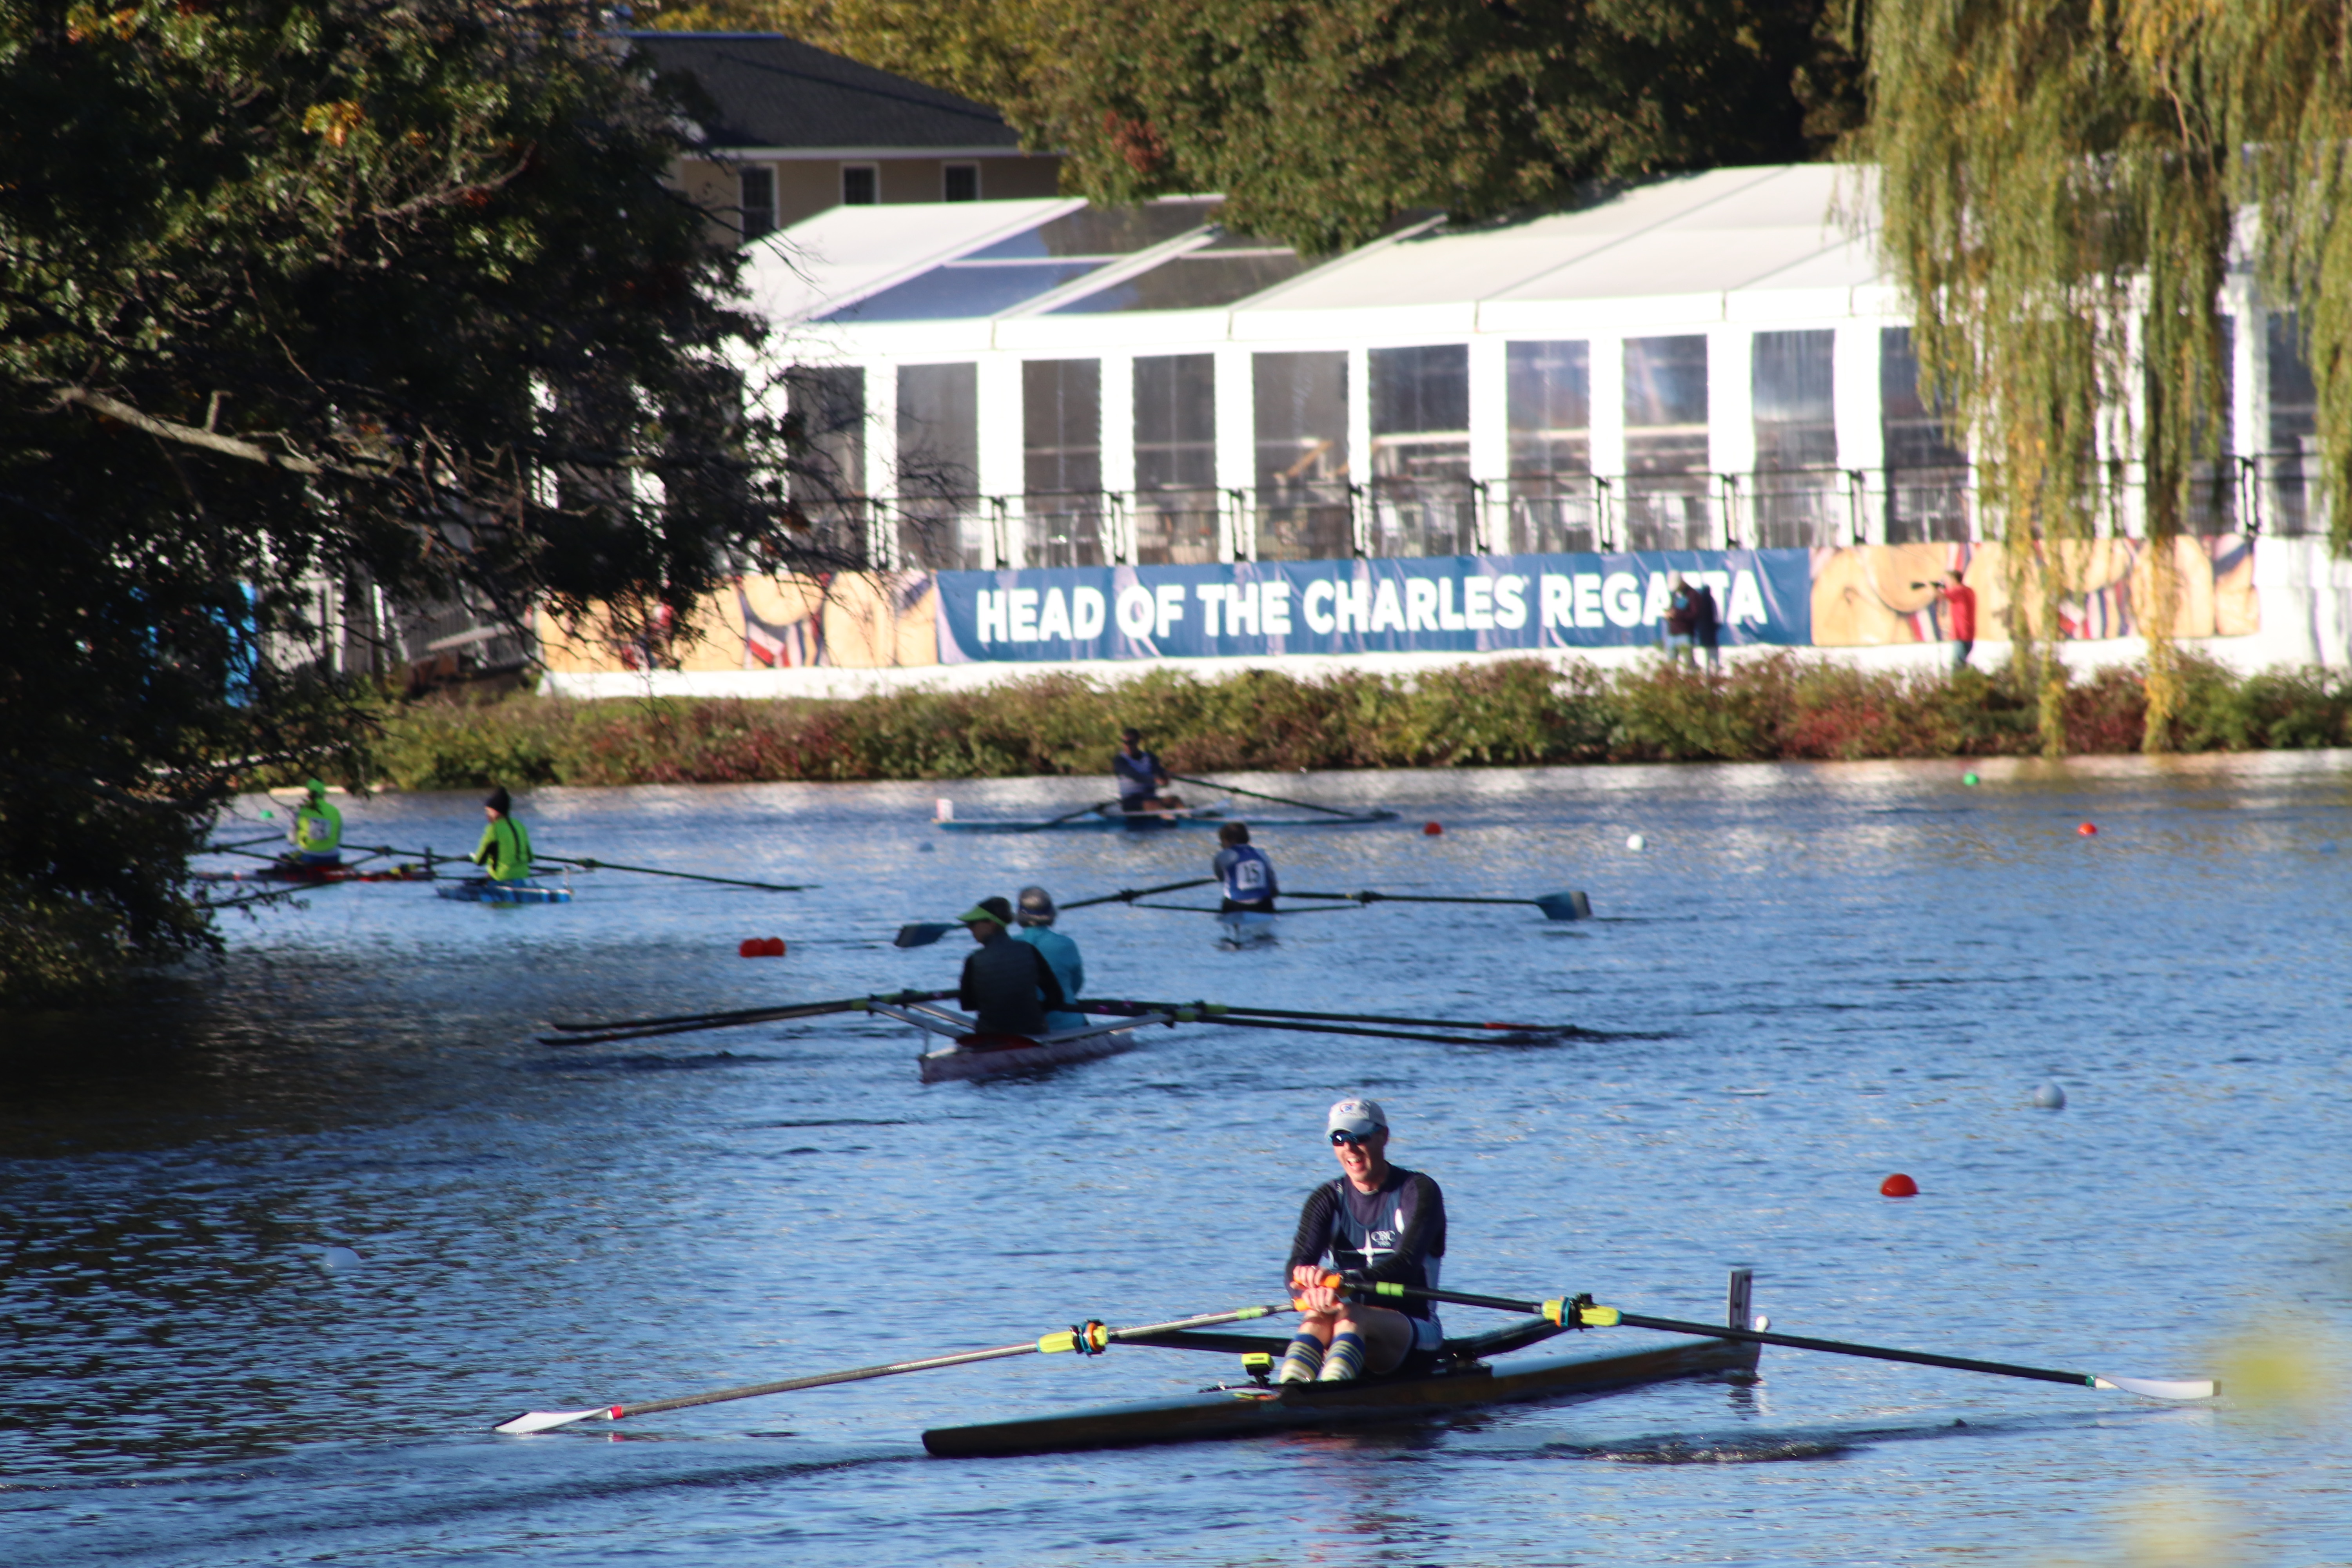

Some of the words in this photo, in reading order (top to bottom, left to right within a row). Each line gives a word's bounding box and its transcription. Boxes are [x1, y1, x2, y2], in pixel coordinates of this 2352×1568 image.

[977, 586, 1105, 643] HEAD
[1116, 585, 1185, 639] OF
[1197, 581, 1291, 636] THE
[1243, 863, 1259, 883] 15
